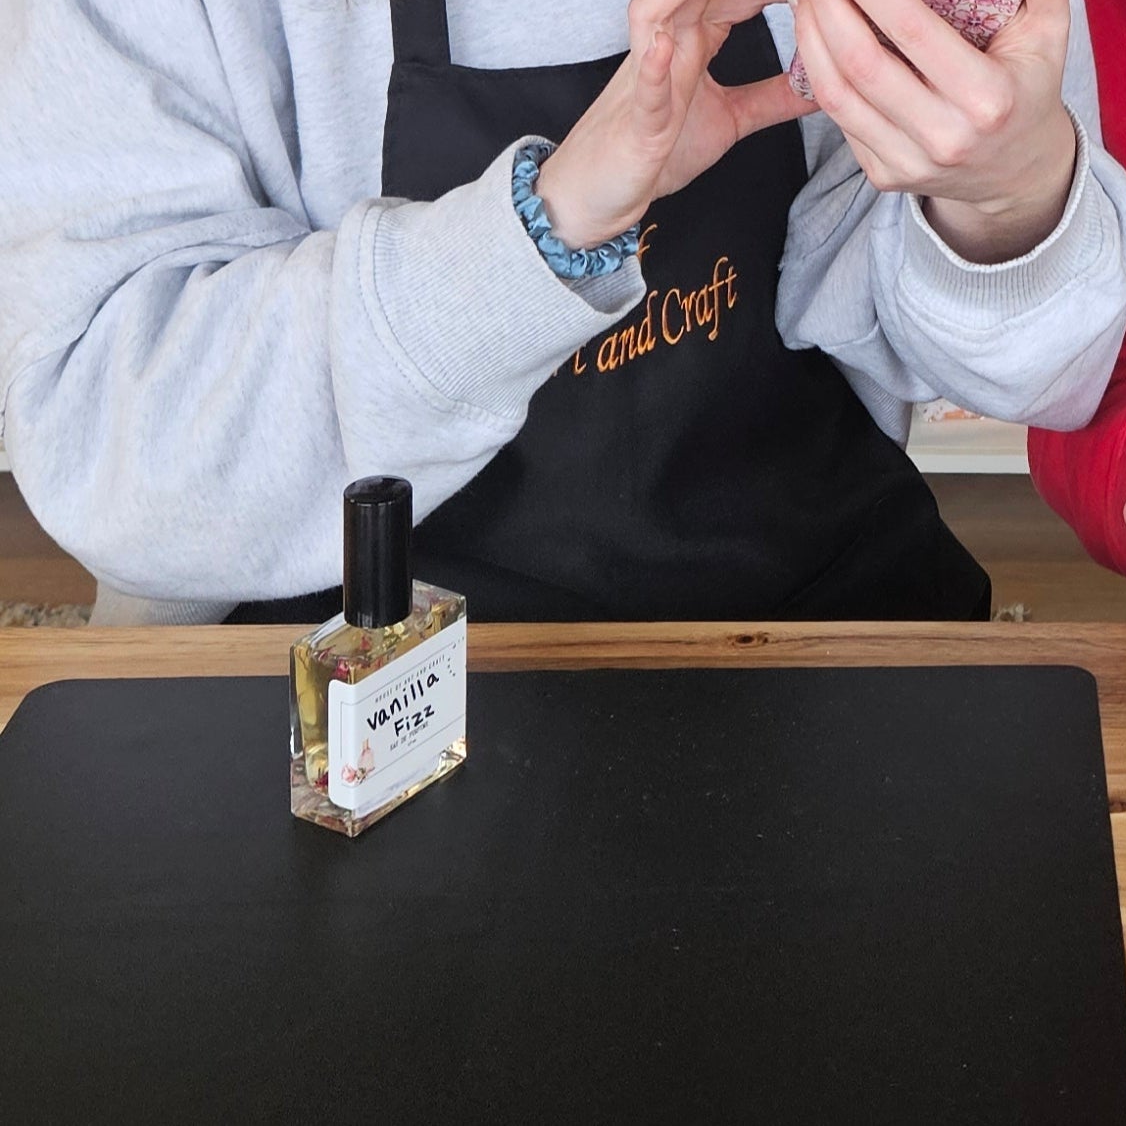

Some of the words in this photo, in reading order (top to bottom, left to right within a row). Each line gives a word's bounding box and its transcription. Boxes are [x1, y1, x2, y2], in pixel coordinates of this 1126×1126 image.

[596, 289, 659, 373] and
[662, 256, 738, 346] Craft
[367, 673, 440, 731] vanilla
[394, 704, 435, 737] Fizz
